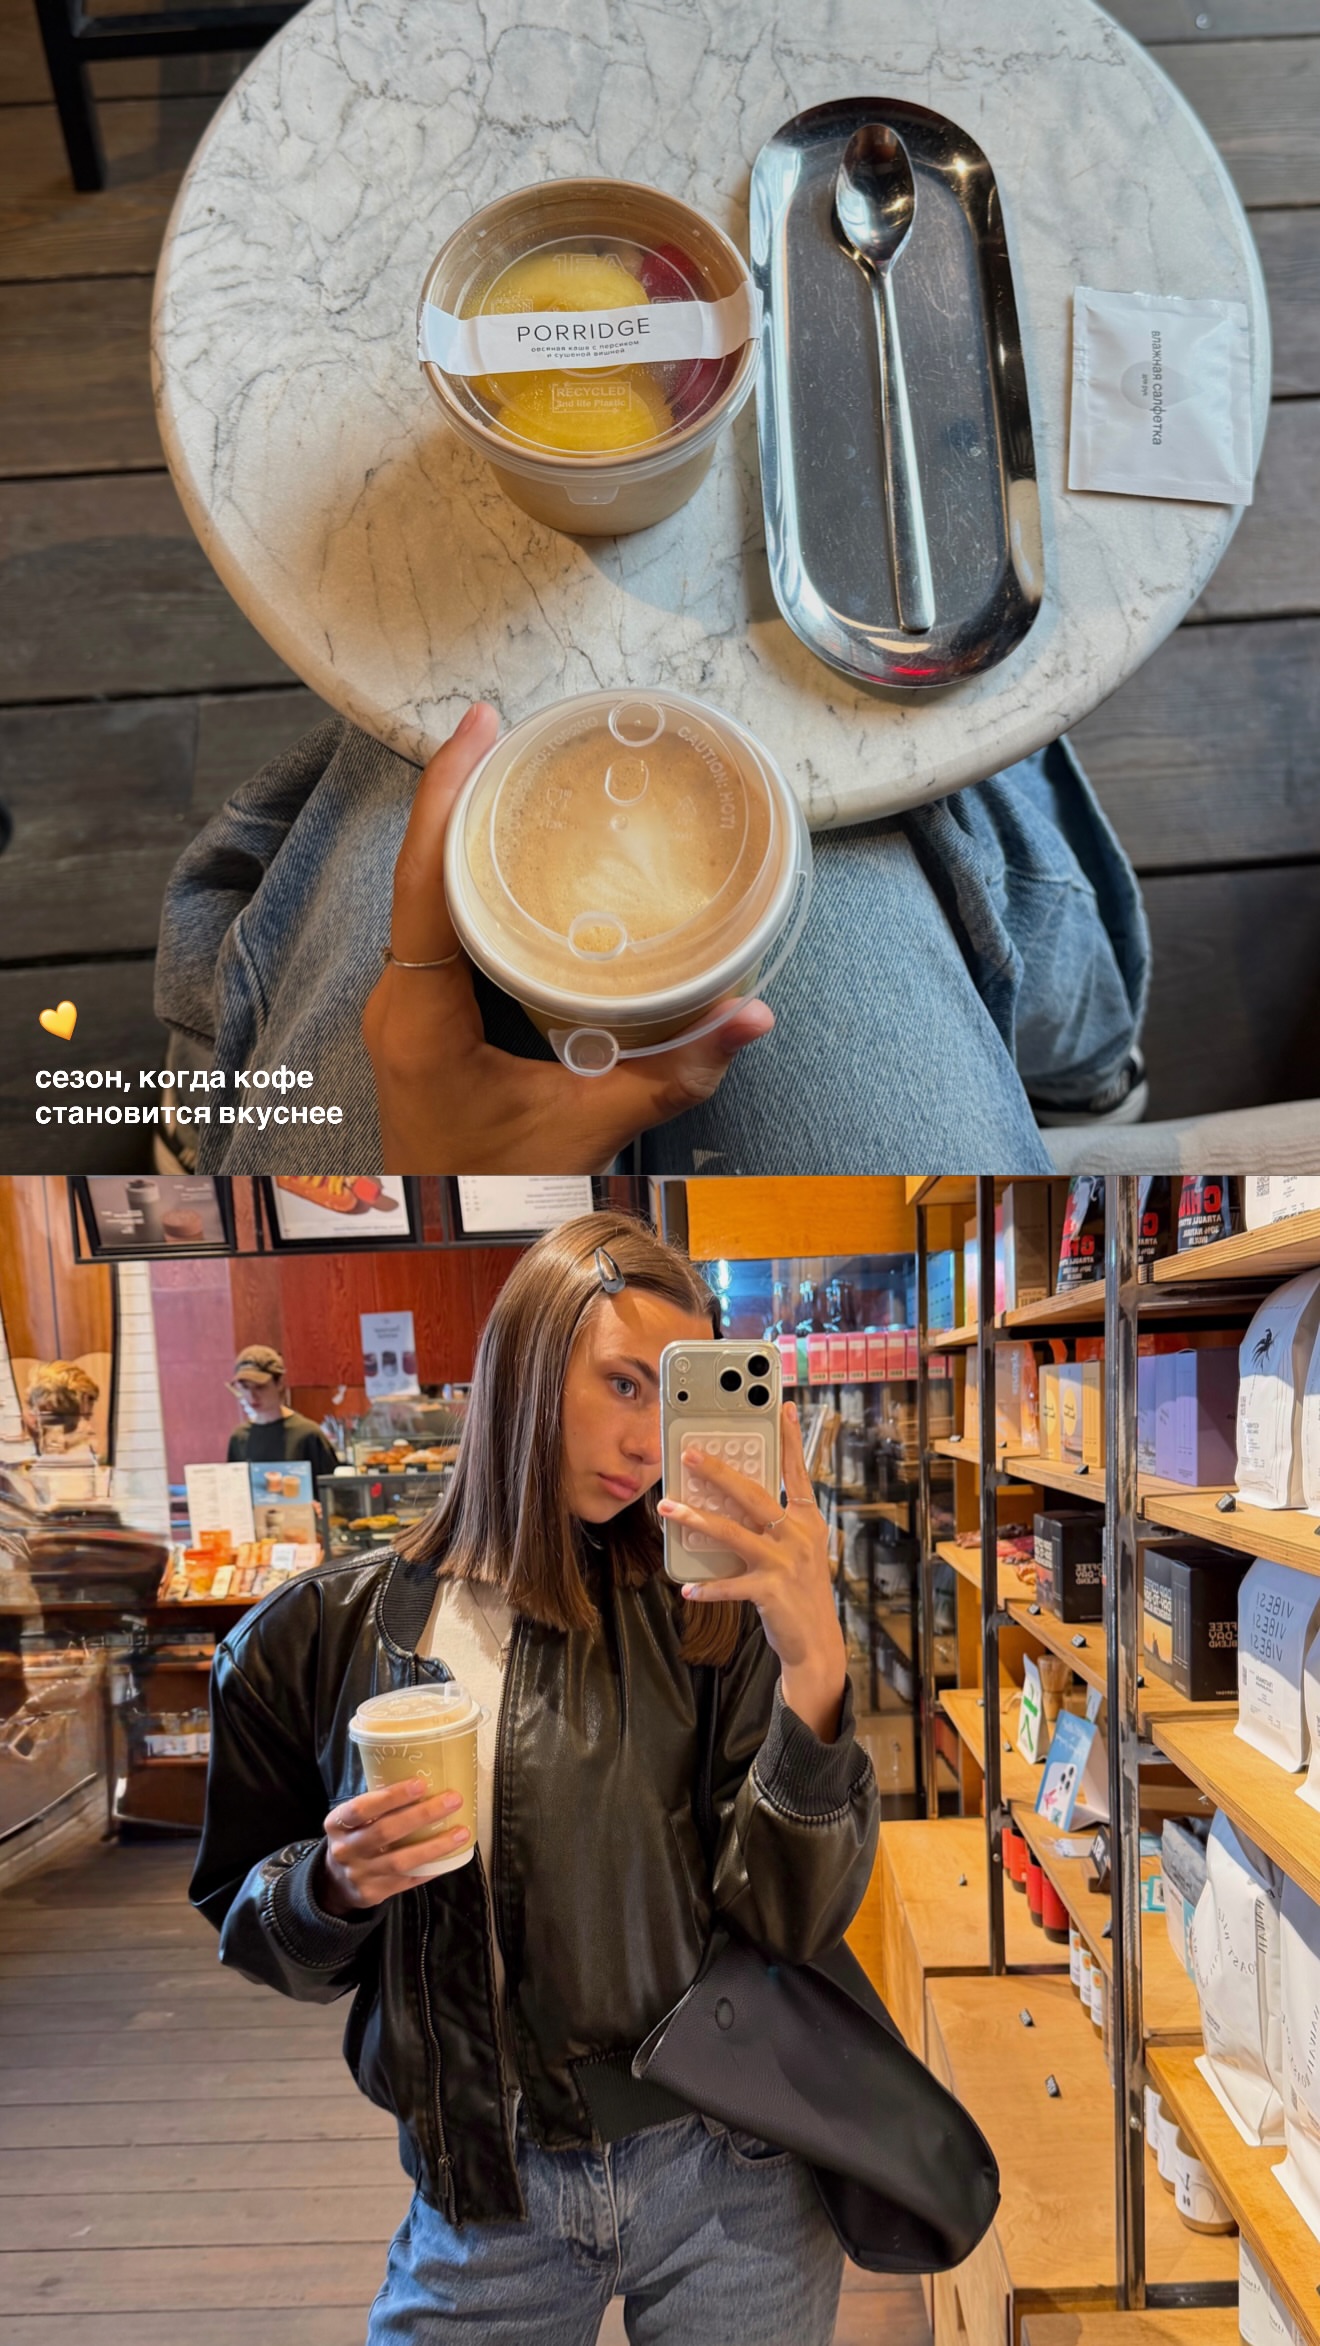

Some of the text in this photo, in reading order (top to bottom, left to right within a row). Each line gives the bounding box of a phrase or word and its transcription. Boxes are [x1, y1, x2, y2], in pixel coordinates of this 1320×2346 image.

[517, 317, 652, 343] PORRIDGE
[531, 345, 566, 353] овсяная
[599, 340, 640, 351] персиком
[554, 351, 591, 359] сушеной
[594, 348, 625, 356] вишней
[556, 387, 626, 397] RECYCLED
[1149, 330, 1167, 445] влажная салфетка
[677, 725, 730, 789] CAUTION:
